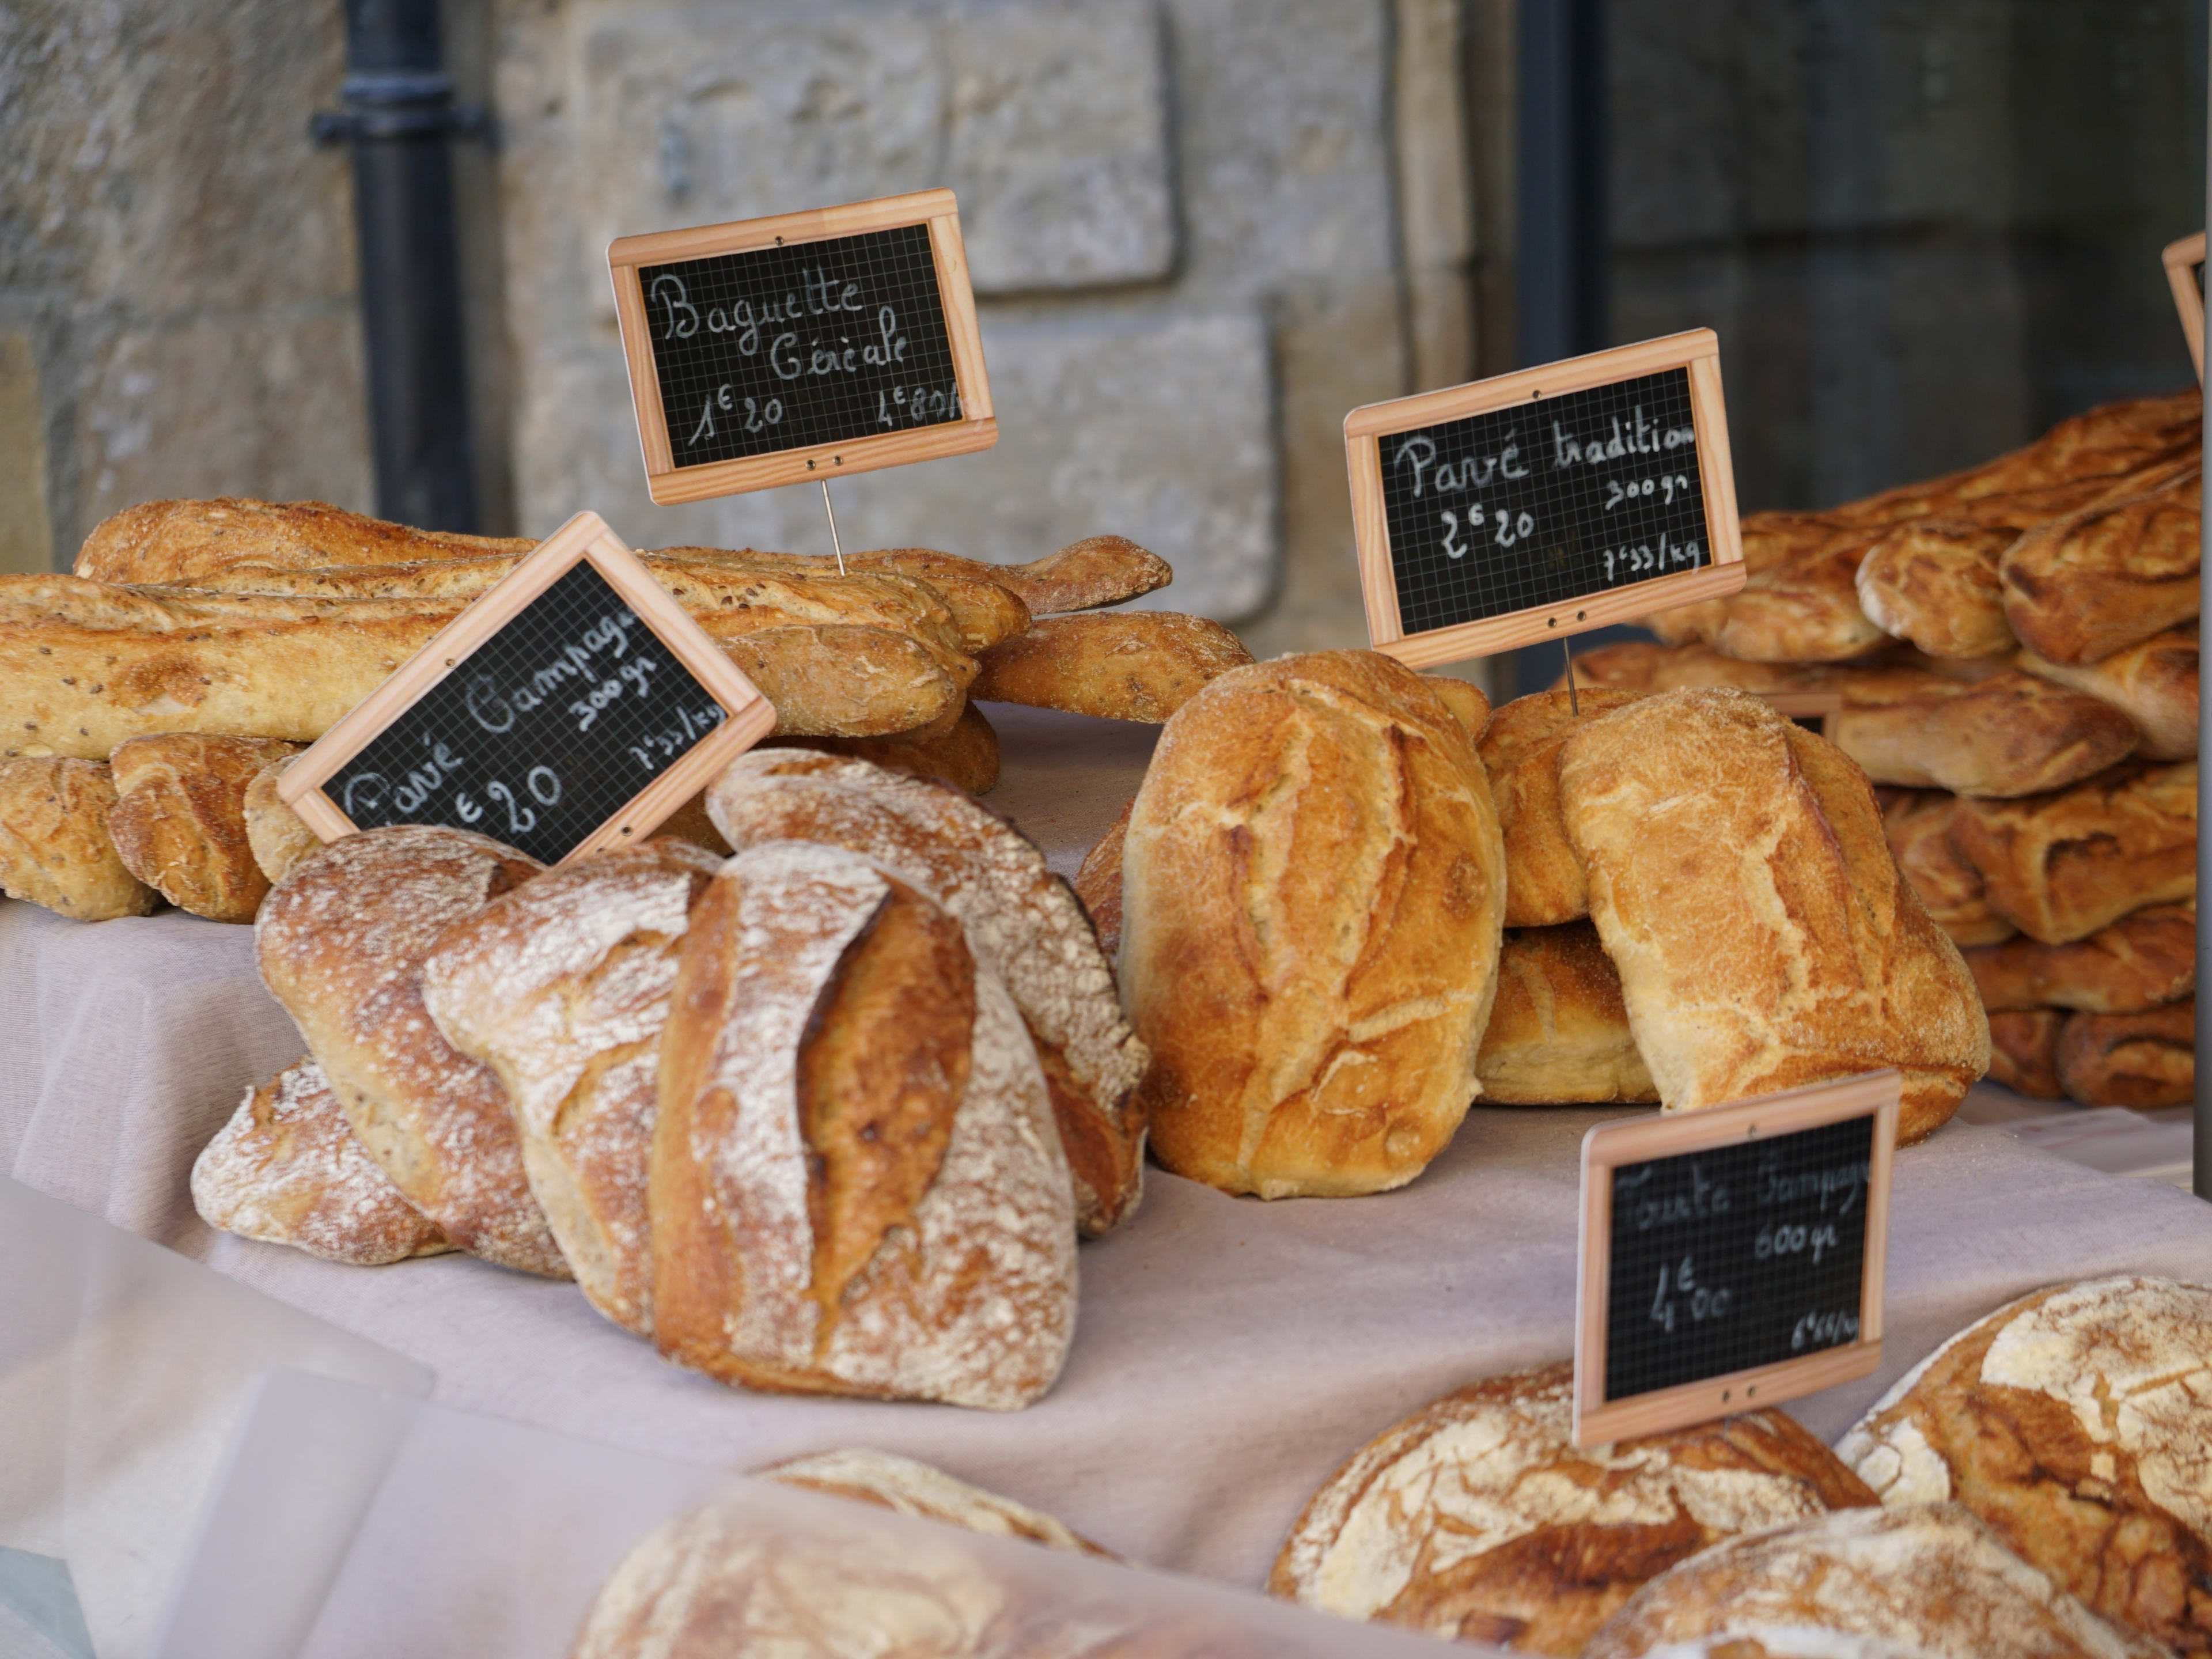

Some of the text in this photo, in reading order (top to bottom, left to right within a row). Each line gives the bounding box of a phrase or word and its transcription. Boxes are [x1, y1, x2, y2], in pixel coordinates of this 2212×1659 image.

[650, 263, 863, 356] Baguette
[1394, 405, 1696, 498] Pavé tradition
[434, 764, 562, 835] €20
